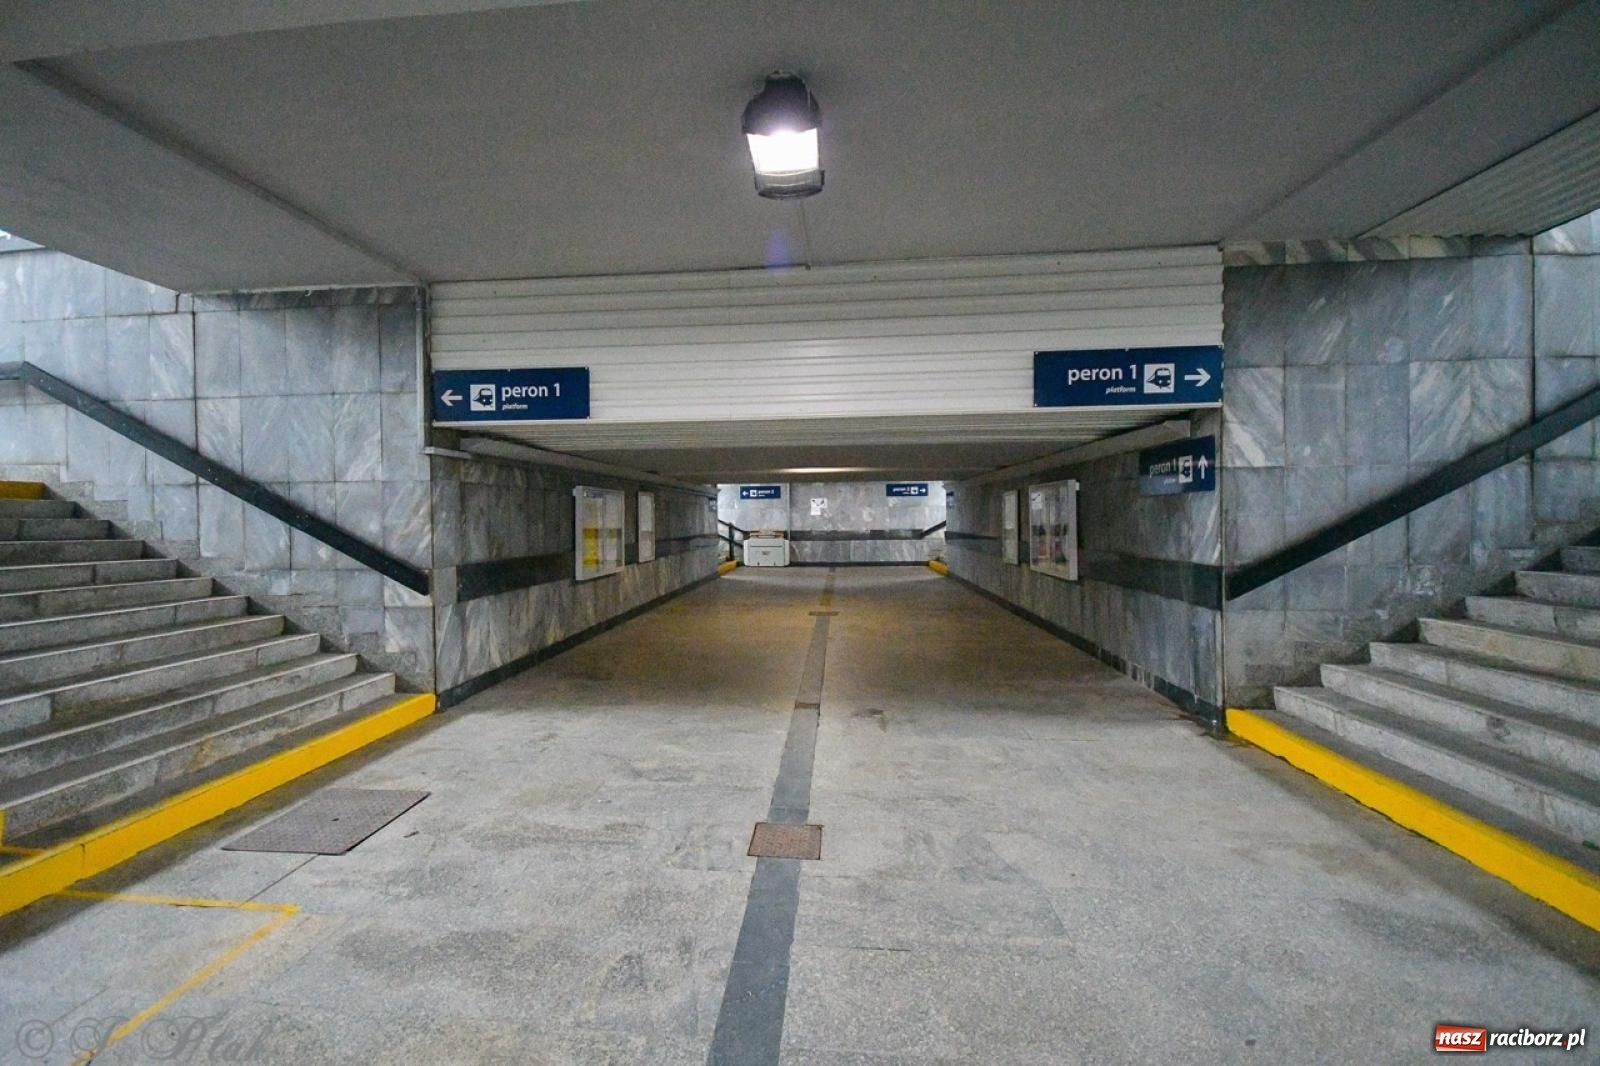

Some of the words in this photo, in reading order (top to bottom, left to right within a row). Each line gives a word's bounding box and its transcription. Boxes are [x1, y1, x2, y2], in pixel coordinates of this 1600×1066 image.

[1068, 367, 1123, 385] peron
[1130, 365, 1137, 380] 1
[501, 385, 548, 401] peron
[553, 382, 560, 397] 1
[1105, 385, 1136, 394] platform
[501, 403, 529, 411] platform
